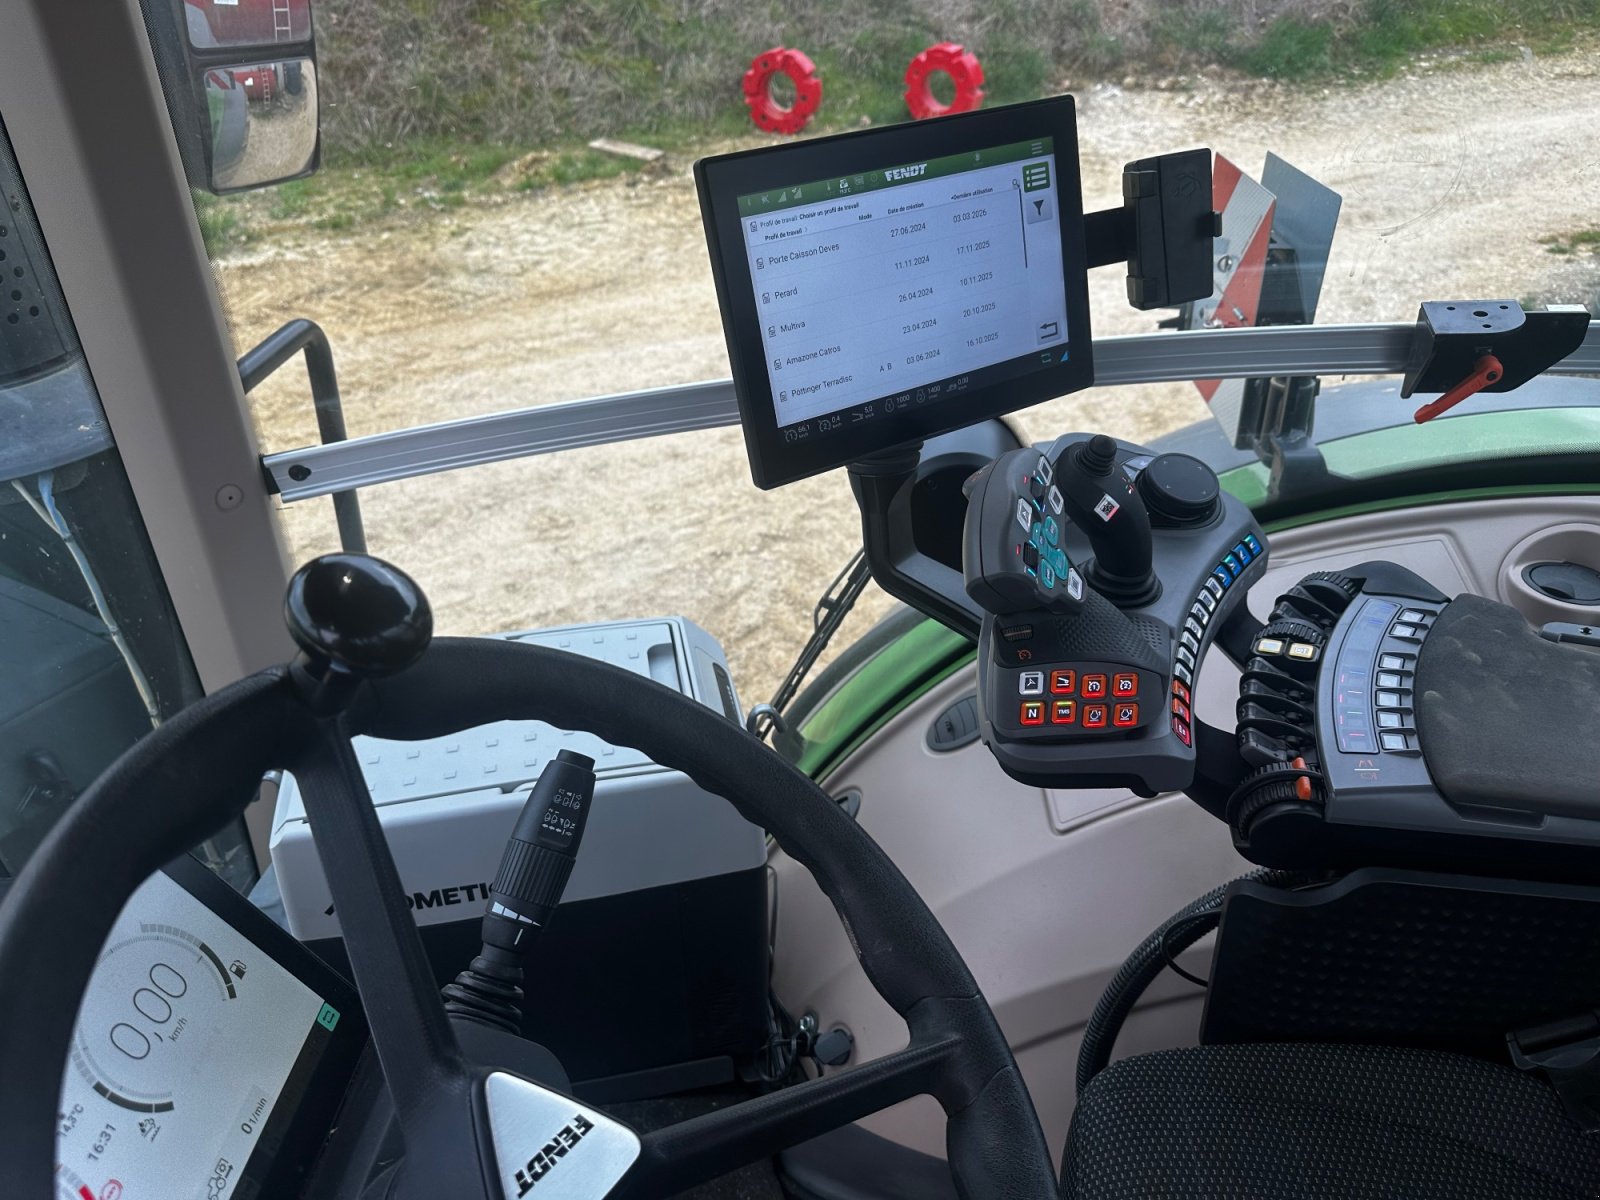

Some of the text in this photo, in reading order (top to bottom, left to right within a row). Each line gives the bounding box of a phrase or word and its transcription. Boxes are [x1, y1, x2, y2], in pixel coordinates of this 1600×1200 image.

[885, 164, 927, 181] FENDT
[799, 212, 816, 220] Choisir
[824, 206, 836, 216] profil
[844, 202, 859, 210] travail
[953, 209, 987, 222] 03.03.2026
[787, 228, 802, 236] travail
[890, 222, 926, 238] 27.06.2024
[768, 243, 840, 265] Porte Caisson Deves
[957, 240, 990, 255] 17.11.2025
[895, 255, 930, 270] 11.11.2024
[960, 272, 993, 287] 10.11.2025
[774, 286, 798, 299] Perard
[899, 287, 933, 302] 26.04.2024
[963, 302, 996, 318] 20.10.2025
[780, 321, 806, 333] Multiva
[902, 318, 937, 334] 23.04.2024
[966, 332, 999, 347] 16.10.2025
[786, 345, 841, 365] Amazone Catros
[906, 349, 940, 365] 03.06.2024
[823, 376, 853, 388] Terradisc
[928, 385, 940, 394] 1400
[897, 395, 910, 403] 1000
[1028, 708, 1037, 718] N
[110, 963, 187, 1060] 0,00
[168, 1017, 188, 1042] km/h
[241, 1097, 268, 1135] 0 1/min
[88, 1123, 116, 1161] 16:31
[514, 1113, 595, 1199] FENDT
